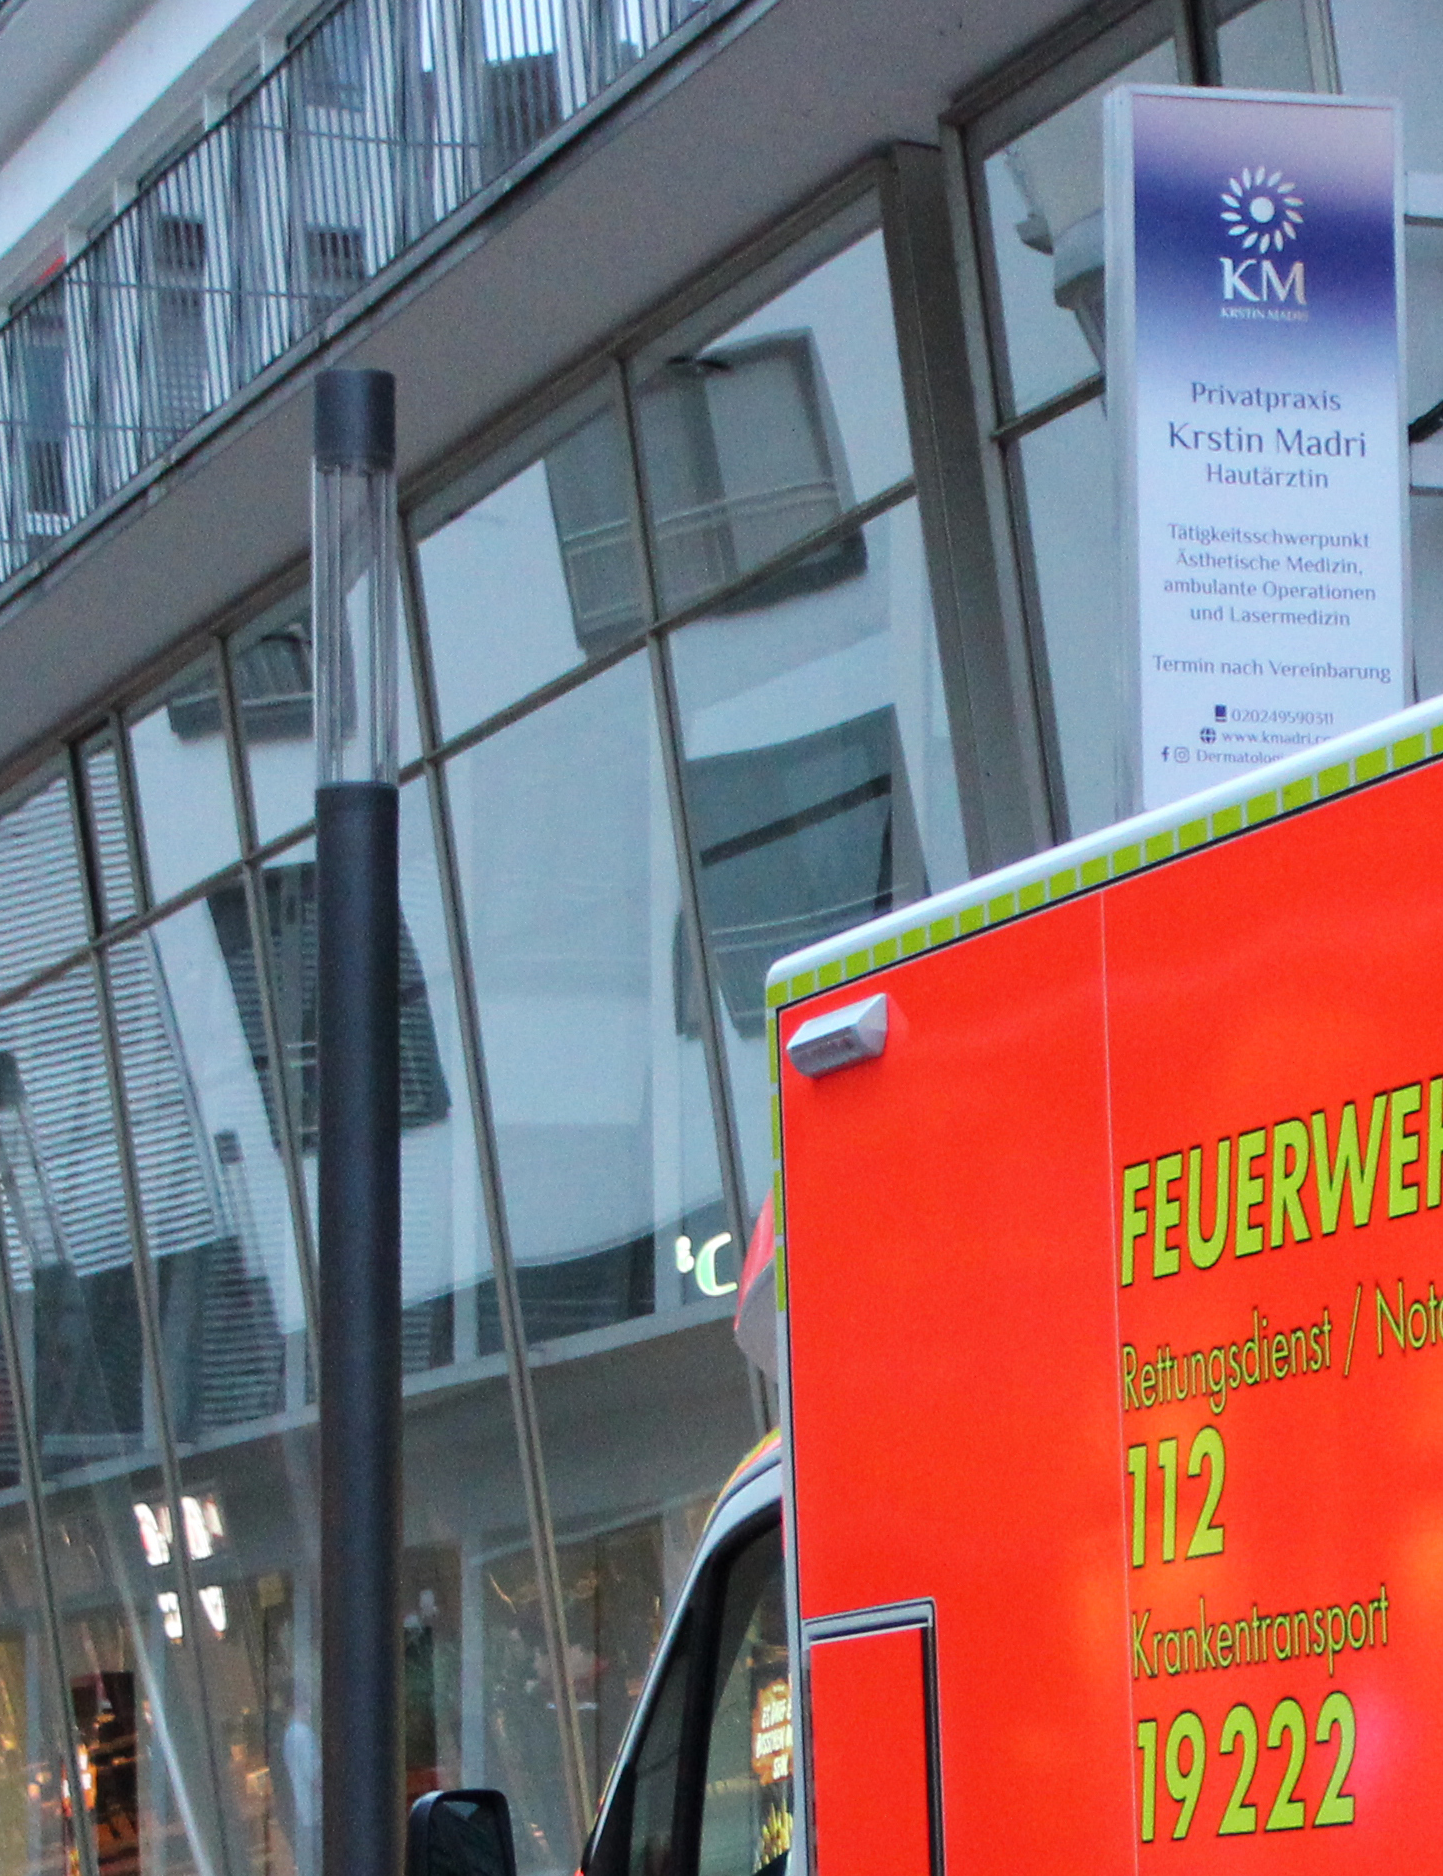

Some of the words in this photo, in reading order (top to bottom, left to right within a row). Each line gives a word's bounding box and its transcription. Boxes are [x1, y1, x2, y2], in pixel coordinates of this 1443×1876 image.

[1219, 256, 1308, 305] KM
[1190, 381, 1341, 413] Privatpraxis
[1168, 421, 1263, 453] Krstin
[1276, 427, 1366, 457] Madri
[1206, 462, 1329, 488] Hautärztin
[1176, 548, 1280, 571] Ästhetische
[1287, 556, 1363, 576] Medizin,
[1163, 578, 1257, 597] ambulante
[1262, 580, 1377, 601] Operationen
[1189, 606, 1224, 622] und
[1230, 605, 1351, 627] Lasermedizin
[1153, 655, 1215, 674] Termin
[1220, 659, 1263, 675] nach
[1268, 659, 1391, 684] Vereinbarung
[1122, 1306, 1333, 1415] Rettungsdienst
[1126, 1424, 1226, 1569] 112
[1131, 1582, 1390, 1680] Krankentransport
